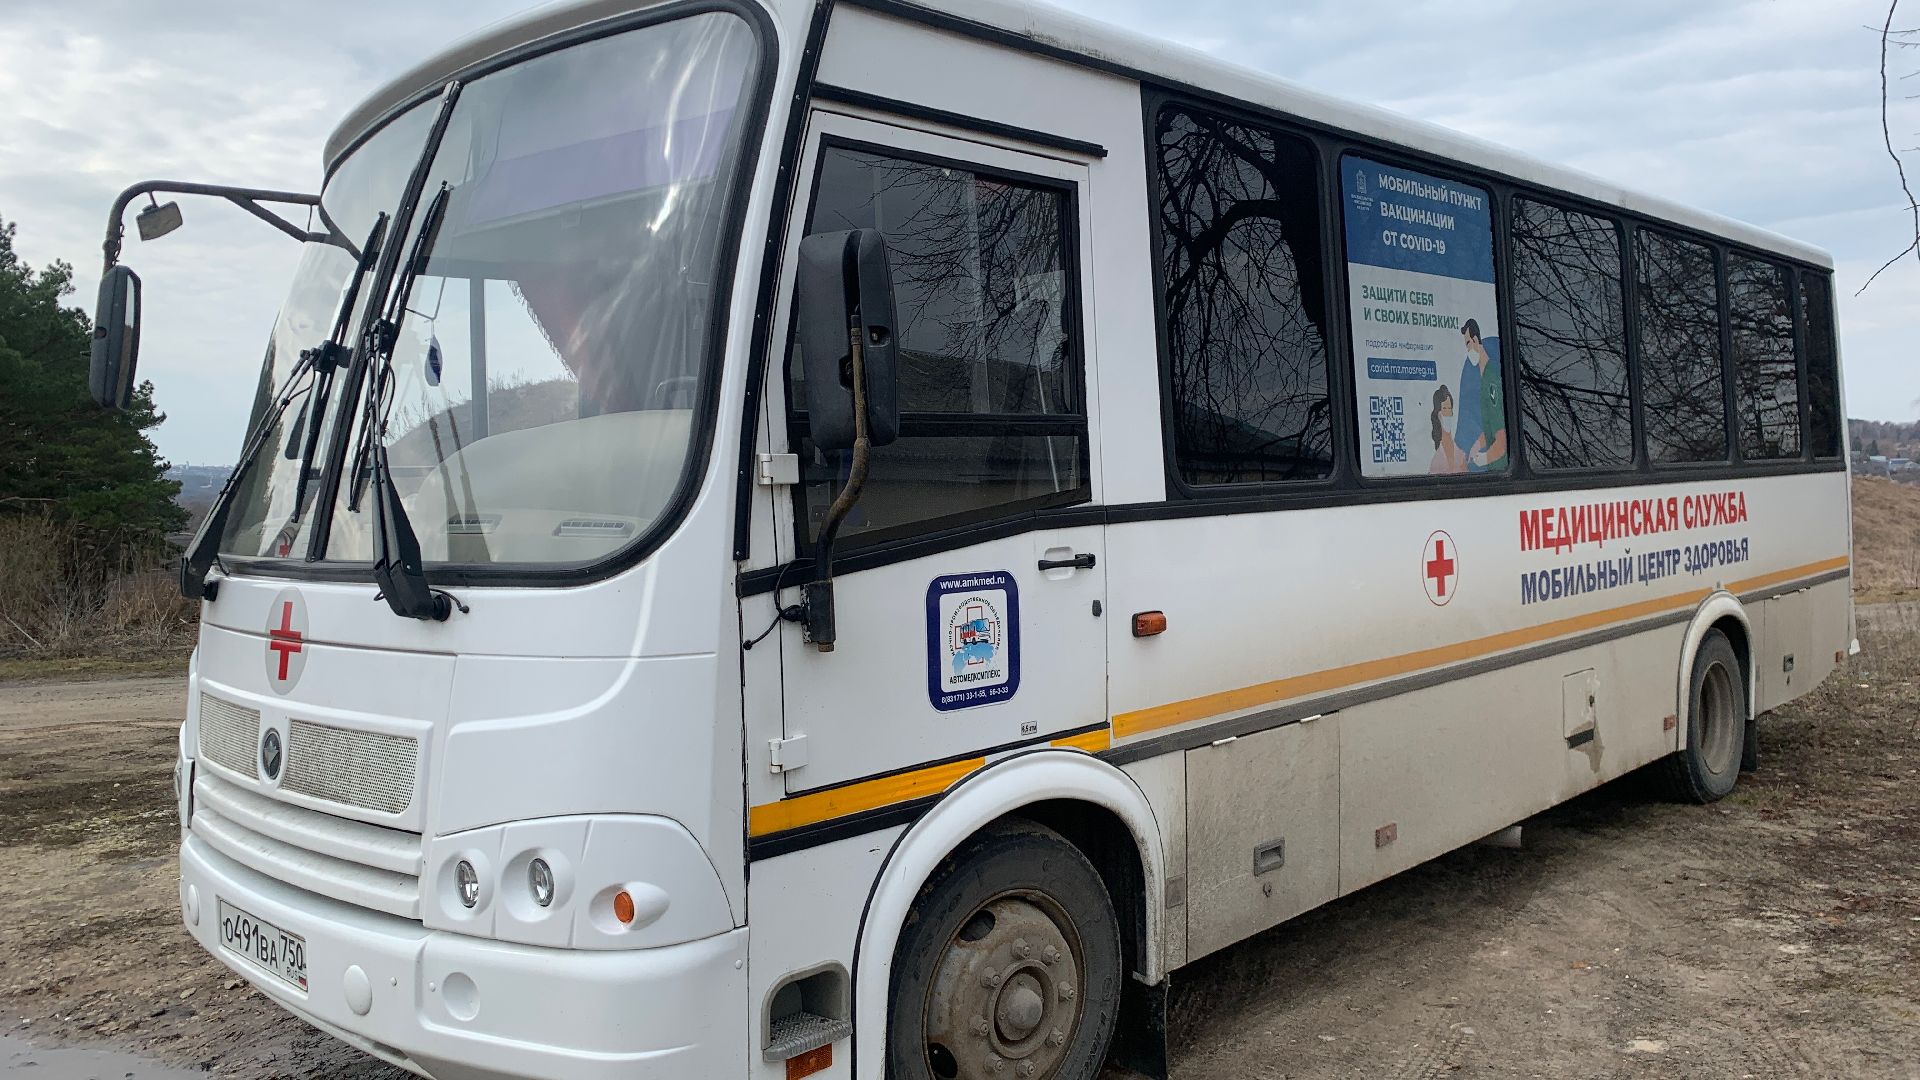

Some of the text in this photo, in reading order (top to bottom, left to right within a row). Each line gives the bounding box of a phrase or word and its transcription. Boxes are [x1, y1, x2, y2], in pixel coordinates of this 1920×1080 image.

[1379, 173, 1448, 202] МОБИЛЬНЫЙ
[1450, 190, 1482, 211] ПУНКТ
[1380, 201, 1455, 231] ВАКЦИНАЦИИ
[1382, 230, 1446, 255] ОТ COVID-19
[1362, 284, 1434, 307] ЗАЩИТИ СЕБЯ
[1363, 307, 1460, 330] И СВОИХ БЛИЗКИХ!
[1365, 338, 1434, 352] подробная информация
[1370, 362, 1435, 378] covid.mz.mosreg.ru
[1519, 491, 1748, 556] МЕДИЦИНСКАЯ СЛУЖБА
[940, 575, 1006, 590] www.amkmed.ru
[1521, 537, 1749, 606] МОБИЛЬНЫЙ ЦЕНТР ЗДОРОВЬЯ
[949, 669, 1001, 685] АВТОМЕДКОМПЛЕКС
[941, 692, 966, 705] 8(83171)
[225, 914, 304, 971] О491ВА 750
[286, 966, 300, 980] RUS
